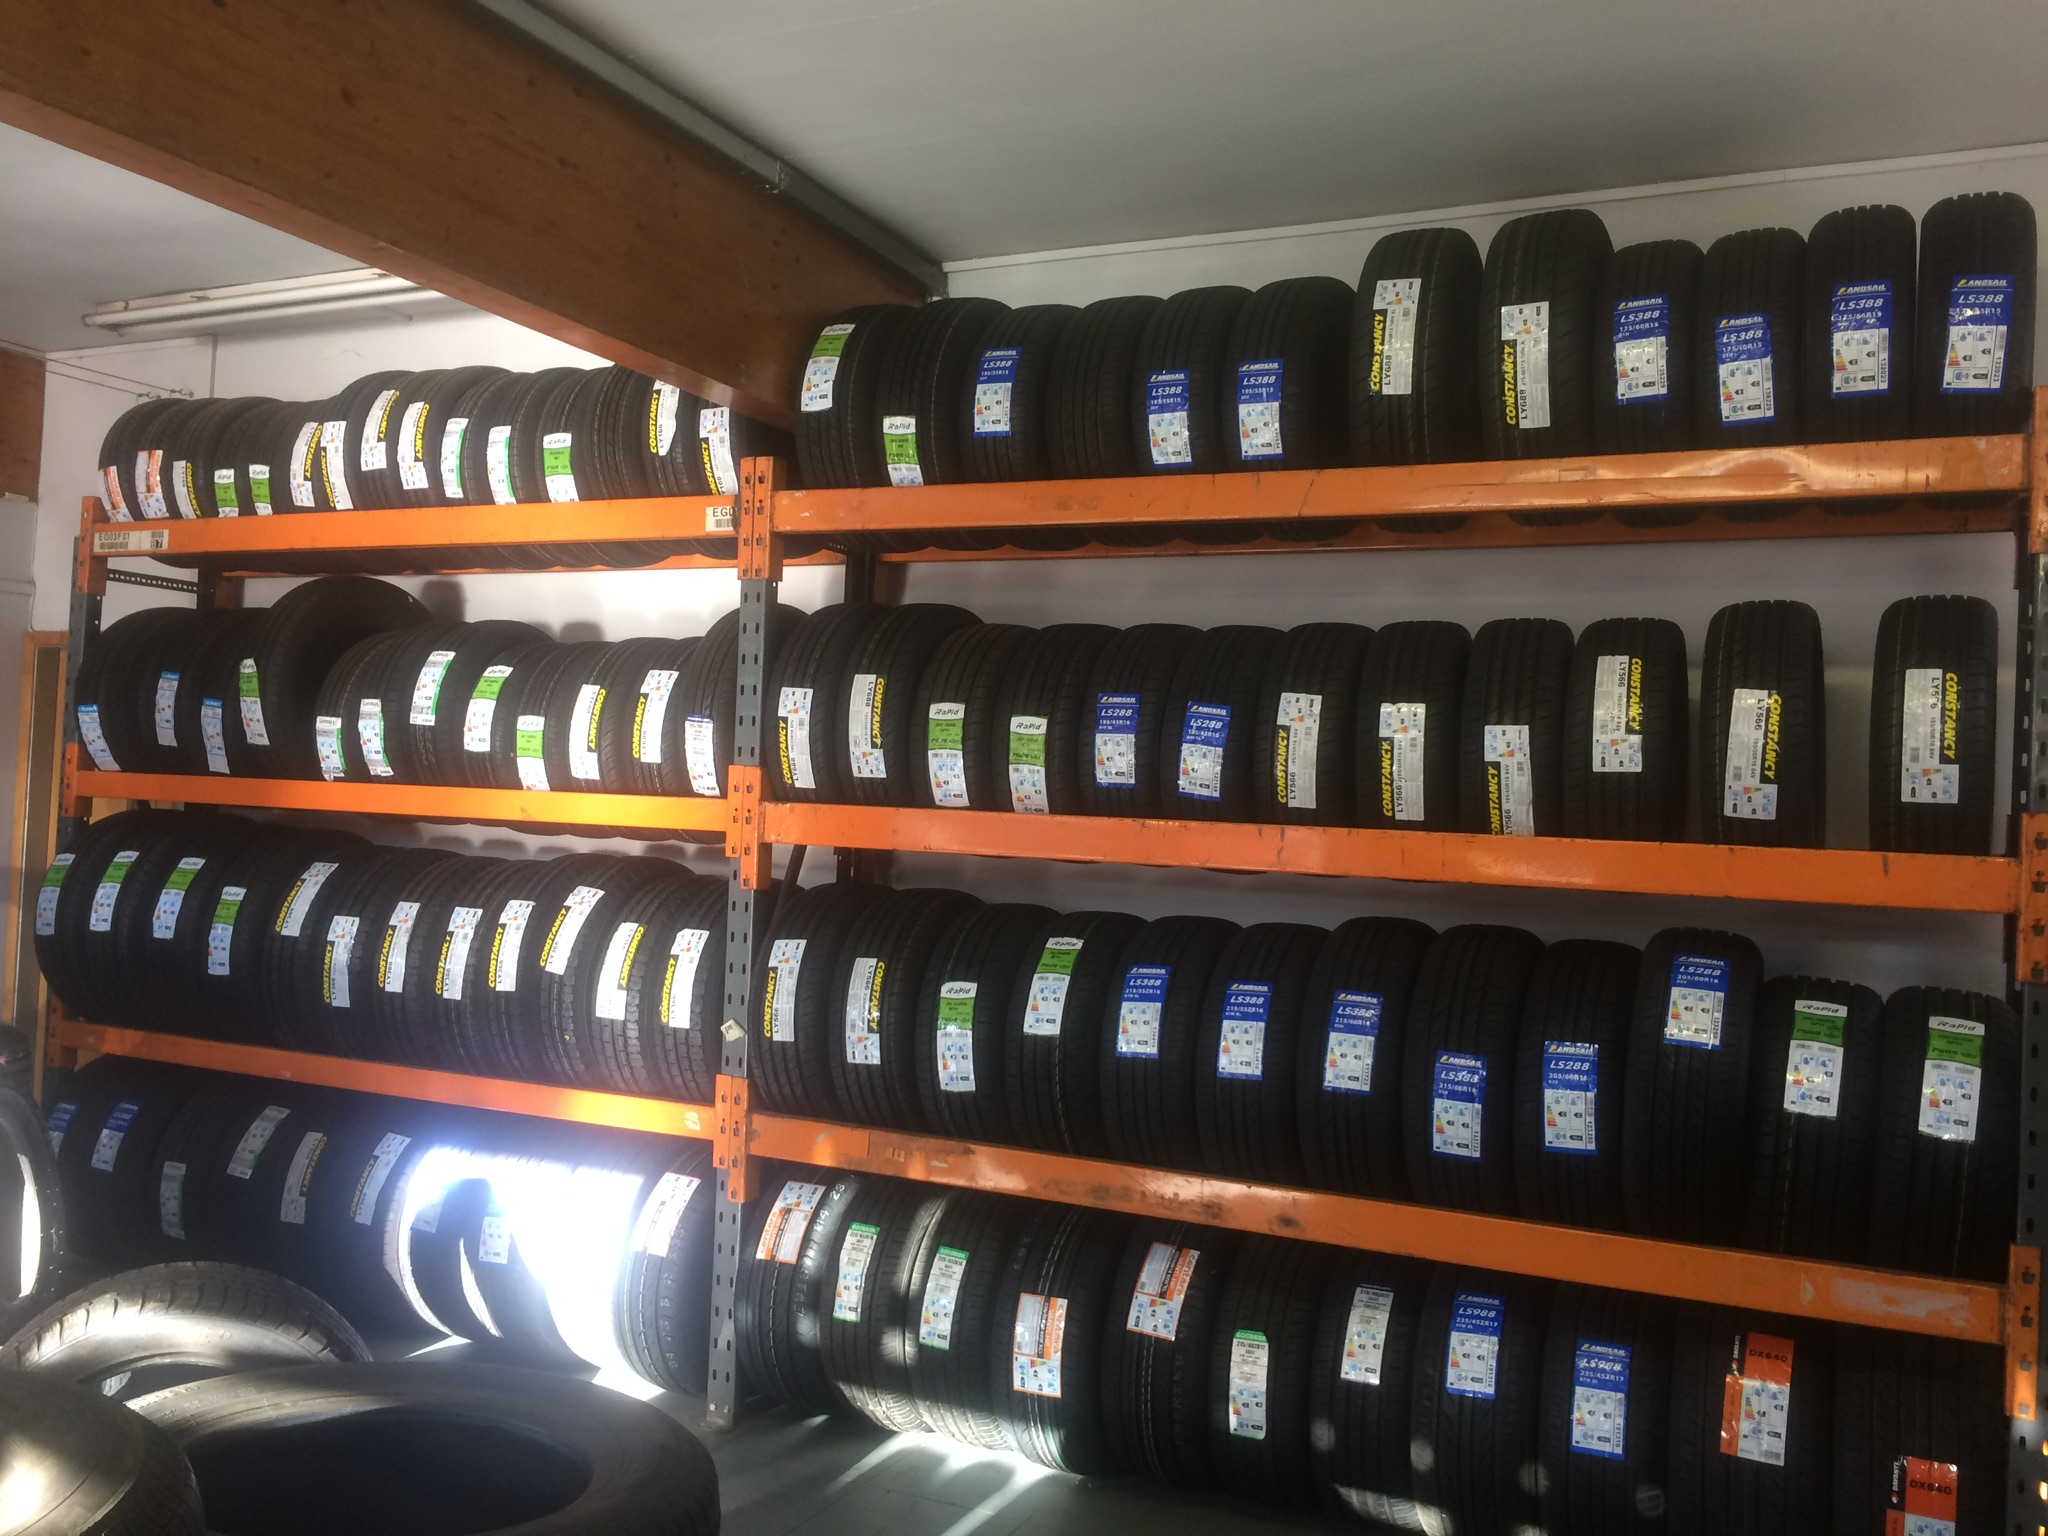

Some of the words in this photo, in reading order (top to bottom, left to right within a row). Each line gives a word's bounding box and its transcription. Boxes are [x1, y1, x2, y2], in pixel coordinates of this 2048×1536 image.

[1837, 284, 1886, 295] LANDSAIL
[1957, 279, 2008, 287] LANDSAIL
[1618, 298, 1663, 310] LANDSAIL
[1840, 298, 1884, 310] LS388
[1958, 294, 2004, 304] LS388
[1620, 310, 1660, 322] LS388
[1619, 322, 1659, 332] 175/60R15
[1722, 330, 1764, 342] LS388
[1371, 313, 1384, 392] CONSTANCY
[984, 360, 1013, 368] LS388
[1242, 362, 1280, 371] LANDSAIL
[1384, 354, 1393, 386] LY688
[1993, 356, 2002, 382] 132023
[1150, 374, 1185, 382] LANDSAIL
[1243, 376, 1276, 385] LS388
[1506, 344, 1516, 424] CONSTANCY
[1152, 386, 1183, 396] LS388
[1520, 390, 1528, 420] LY688
[378, 390, 400, 439] CONSTANCY
[649, 392, 660, 454] CONSTANCY
[415, 404, 430, 460] CONSTANCY
[304, 424, 323, 478] CONSTANCY
[702, 441, 722, 496] ONSTANCY
[320, 450, 335, 508] CONSTANCY
[186, 462, 202, 516] CONSTANCY
[712, 507, 738, 518] EG0
[98, 532, 130, 542] EG03F01
[1618, 662, 1627, 688] LY566
[866, 682, 874, 708] LY688
[1629, 658, 1642, 730] CONSTANCY
[873, 678, 885, 747] CONSTANCY
[934, 708, 960, 716] RaPid
[1101, 708, 1133, 716] LS288
[1190, 706, 1228, 716] LANDSAIL
[1754, 698, 1766, 731] LY566
[1944, 672, 1958, 760] CONSTANCY
[588, 688, 606, 750] CONSTANCY
[1190, 718, 1223, 729] LS288
[632, 696, 647, 759] CONSTANCY
[1016, 722, 1042, 730] RaPid
[1765, 694, 1782, 780] CONSTANCY
[780, 720, 792, 784] CONSTANCY
[791, 758, 799, 782] LY688
[1276, 728, 1289, 804] CONSTANCY
[1382, 740, 1393, 817] CONSTANCY
[1396, 784, 1404, 814] LY566
[1504, 808, 1512, 835] LY566
[275, 880, 302, 932] CONSTANCY
[540, 908, 568, 967] CONSTANCY
[378, 928, 394, 988] CONSTANCY
[488, 926, 504, 988] CONSTANCY
[620, 926, 644, 988] CONSTANCY
[1678, 956, 1726, 966] LANDSAIL
[435, 934, 452, 995] CONSTANCY
[1679, 966, 1722, 976] LS288
[324, 944, 333, 1002] CONSTANCY
[864, 964, 874, 991] LY566
[1676, 974, 1719, 984] 205/60R16
[1130, 978, 1162, 986] LS388
[1230, 984, 1269, 992] LANDSAIL
[661, 957, 677, 1024] CONSTANCY
[870, 961, 886, 1031] CONSTANCY
[764, 970, 776, 1038] CONSTANCY
[1230, 995, 1265, 1004] LS388
[1338, 994, 1378, 1004] LANDSAIL
[1337, 1006, 1375, 1017] LS388
[1802, 1004, 1840, 1014] RaPid
[1796, 1028, 1822, 1036] P609
[1937, 1020, 1977, 1031] RaPid
[1548, 1044, 1594, 1056] LANDSAIL
[1932, 1047, 1958, 1056] P609
[1440, 1055, 1482, 1068] LANDSAIL
[1550, 1060, 1590, 1070] LS288
[1440, 1070, 1480, 1083] LS388
[1548, 1072, 1588, 1081] 205/60R16
[1438, 1082, 1477, 1093] 215/60R16
[1458, 1294, 1500, 1306] LANDSAIL
[1458, 1306, 1496, 1318] LS988
[1456, 1318, 1498, 1328] 235/45ZR17
[1581, 1344, 1626, 1356] LANDSAIL
[1748, 1349, 1788, 1363] DX640
[1580, 1370, 1624, 1382] 235/45ZR17
[1614, 1422, 1622, 1448] 191310
[1910, 1479, 1952, 1494] DX640
